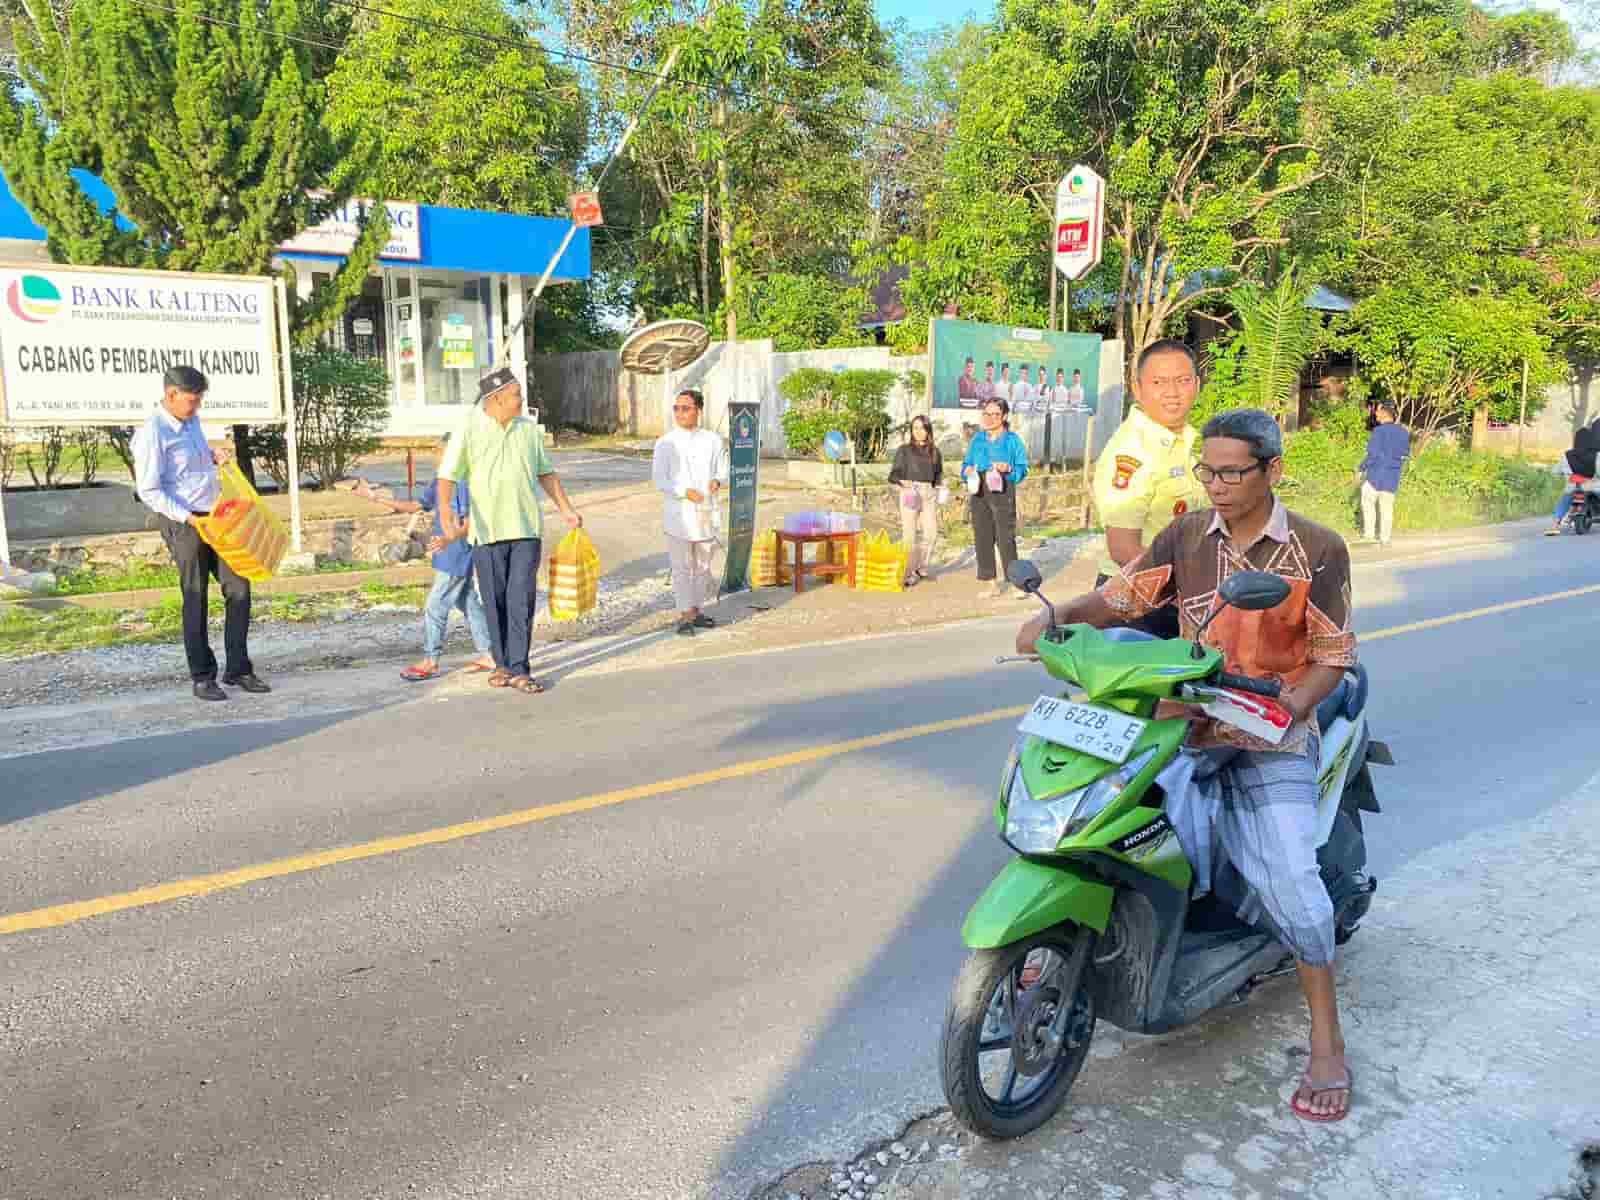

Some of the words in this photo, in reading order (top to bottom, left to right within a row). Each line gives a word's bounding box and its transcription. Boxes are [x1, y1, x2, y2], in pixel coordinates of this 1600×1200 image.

[71, 285, 138, 308] BANK
[149, 289, 258, 314] KALTENG
[18, 345, 95, 374] CABANG
[101, 347, 194, 375] PEMBANTU
[201, 350, 260, 376] KANDUI
[1033, 699, 1058, 720] KH
[1064, 707, 1108, 730] 6228
[1123, 722, 1139, 741] E
[1124, 819, 1166, 848] HONDA
